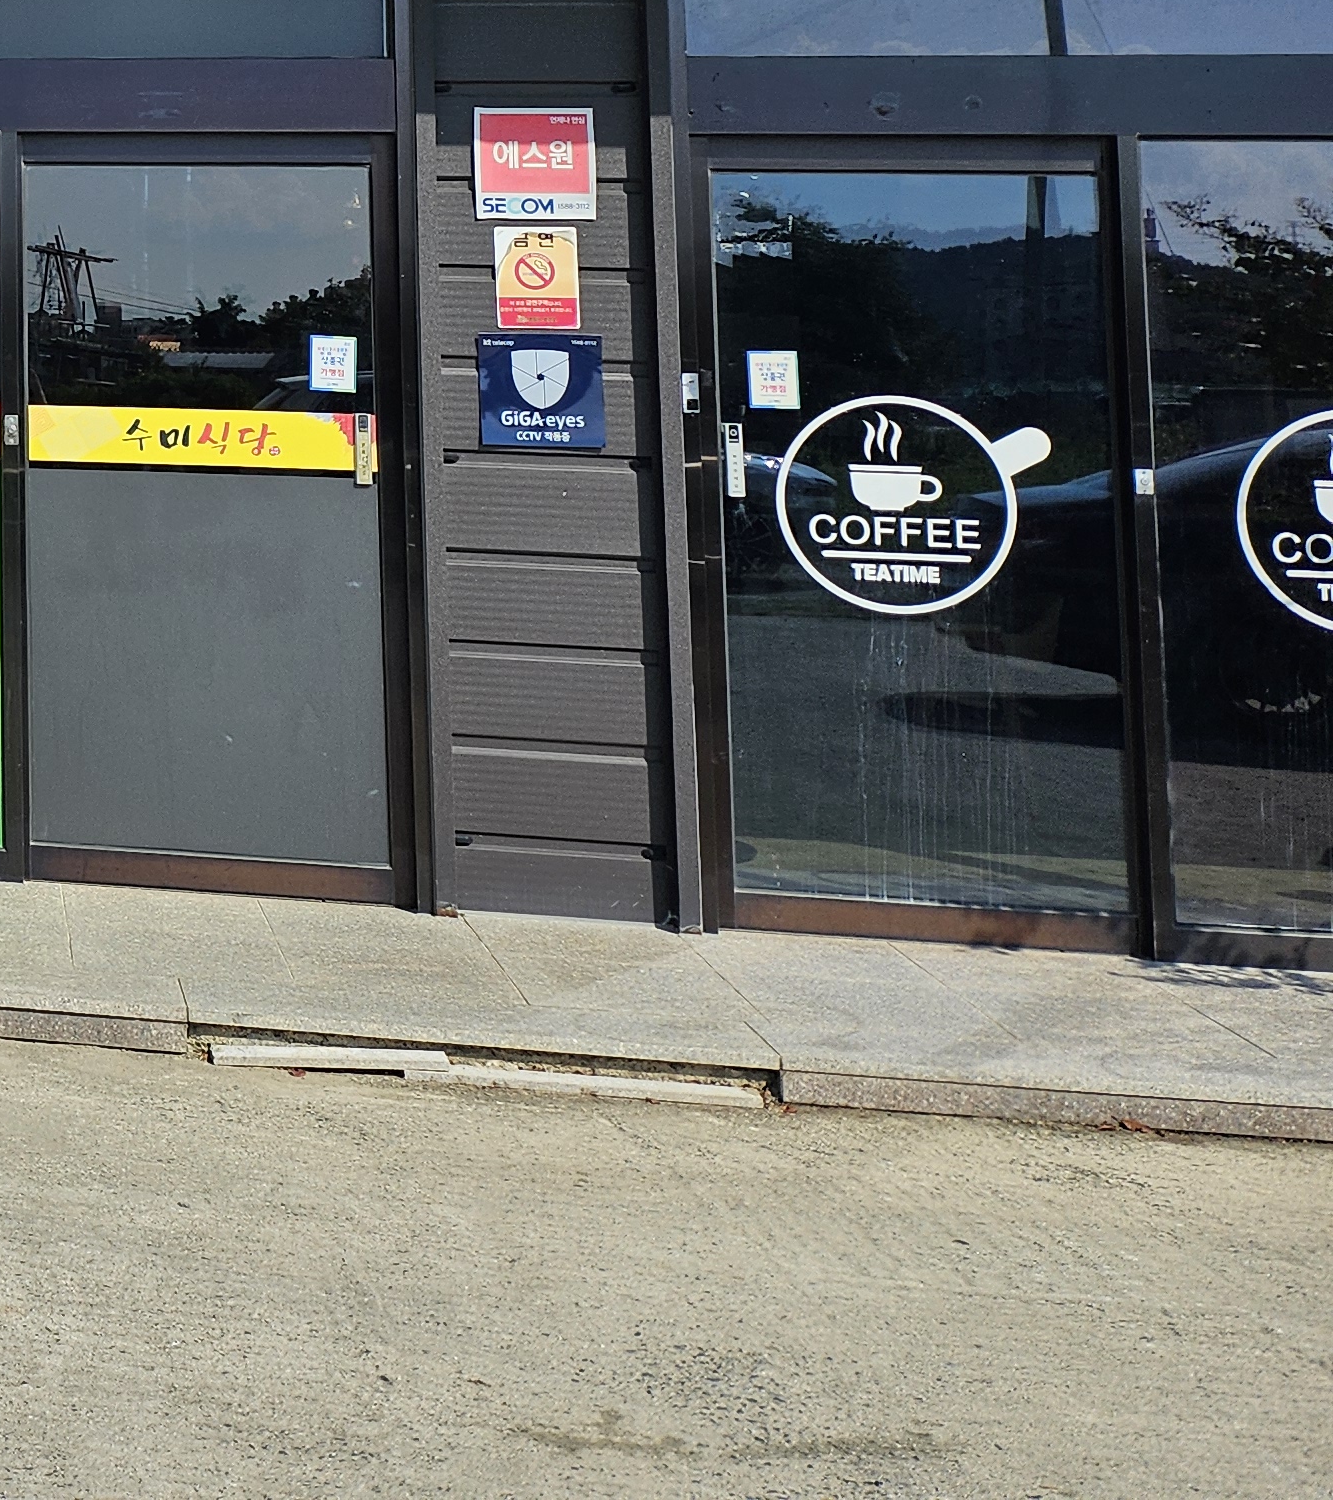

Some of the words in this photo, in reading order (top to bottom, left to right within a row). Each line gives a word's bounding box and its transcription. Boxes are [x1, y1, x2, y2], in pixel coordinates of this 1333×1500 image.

[492, 140, 574, 169] 에스원
[482, 197, 554, 214] SECOM
[122, 418, 277, 456] 수미식당
[516, 431, 543, 441] CCTV
[808, 513, 982, 550] COFFEE
[851, 562, 941, 584] TEATIME
